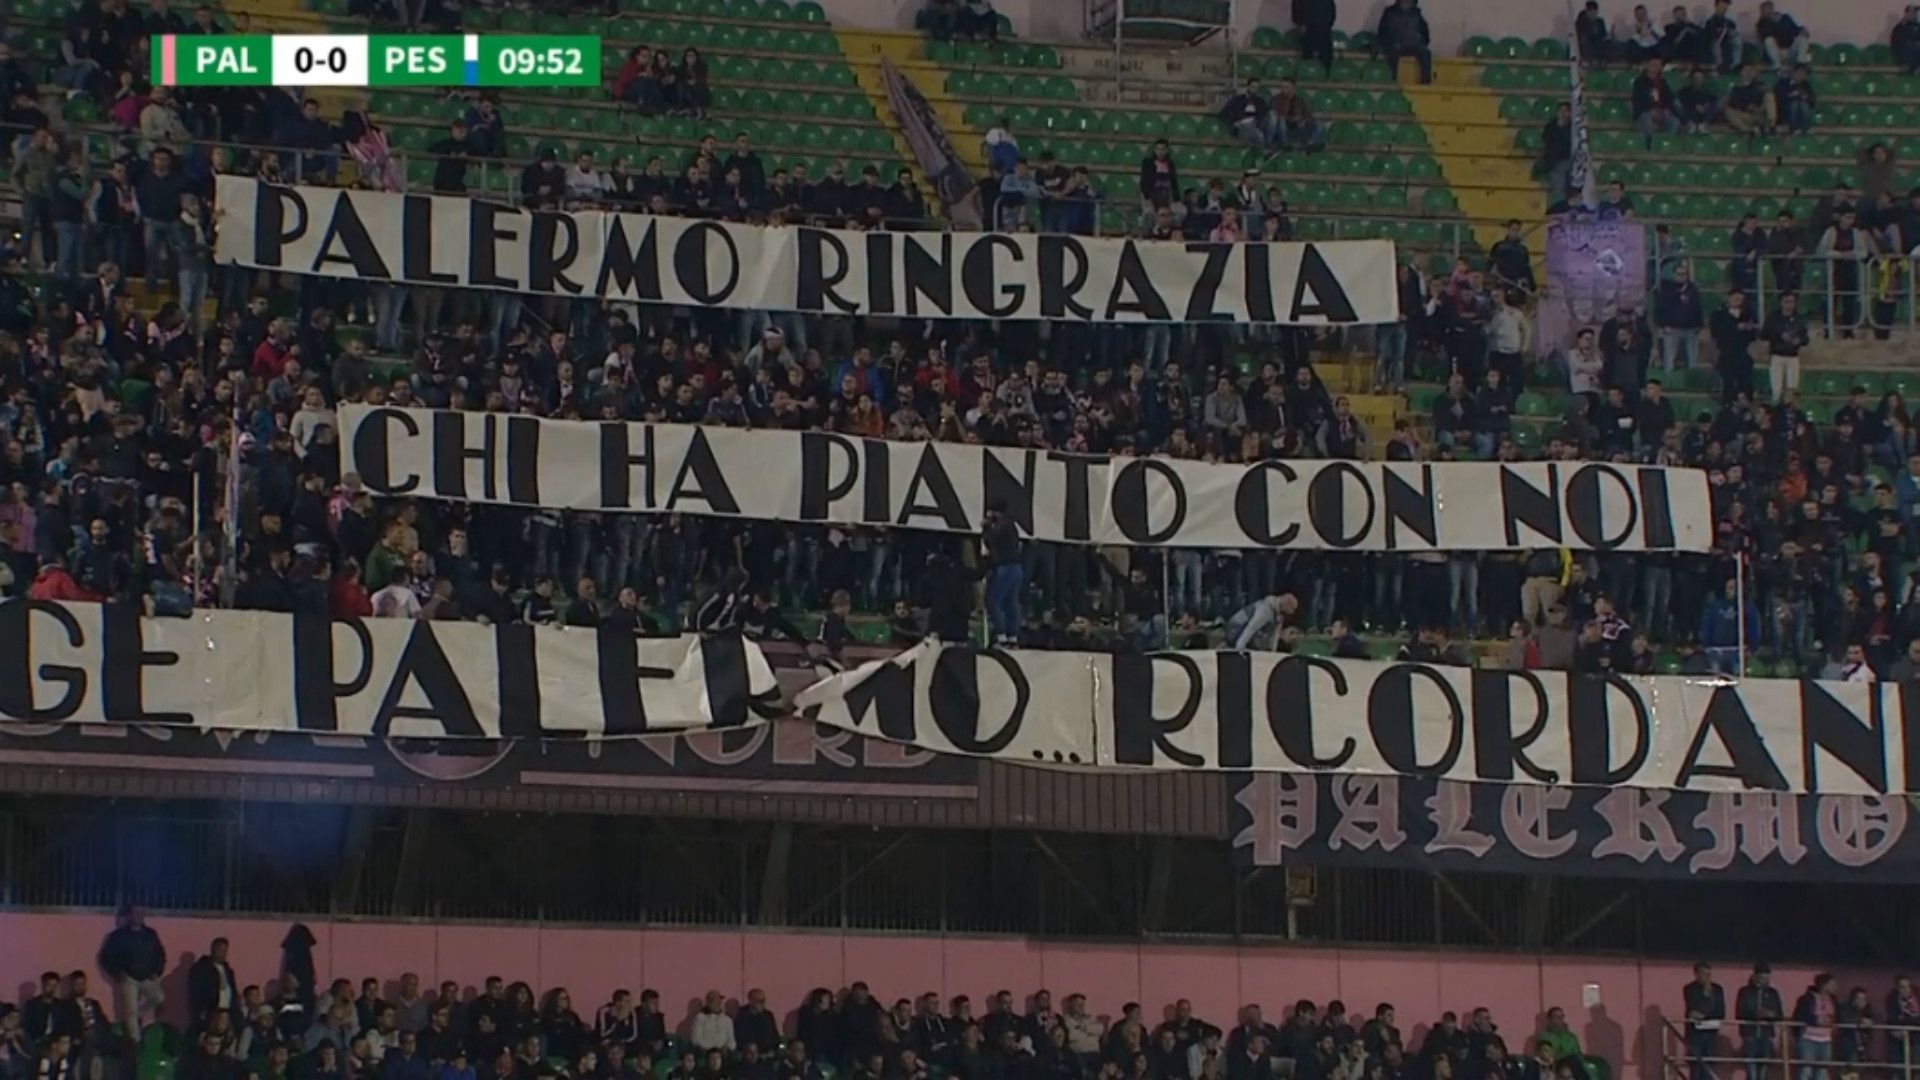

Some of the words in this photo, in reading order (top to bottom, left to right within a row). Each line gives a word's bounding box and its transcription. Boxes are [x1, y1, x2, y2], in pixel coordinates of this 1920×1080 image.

[255, 182, 739, 304] PALERMO
[796, 228, 1359, 321] RINGRAZIA
[353, 409, 539, 504] CHI
[600, 422, 741, 513] HA
[801, 433, 1187, 543] PIANTO
[1234, 460, 1437, 548] CON
[1500, 464, 1676, 548] NOI
[1233, 770, 1908, 874] PALERMO
